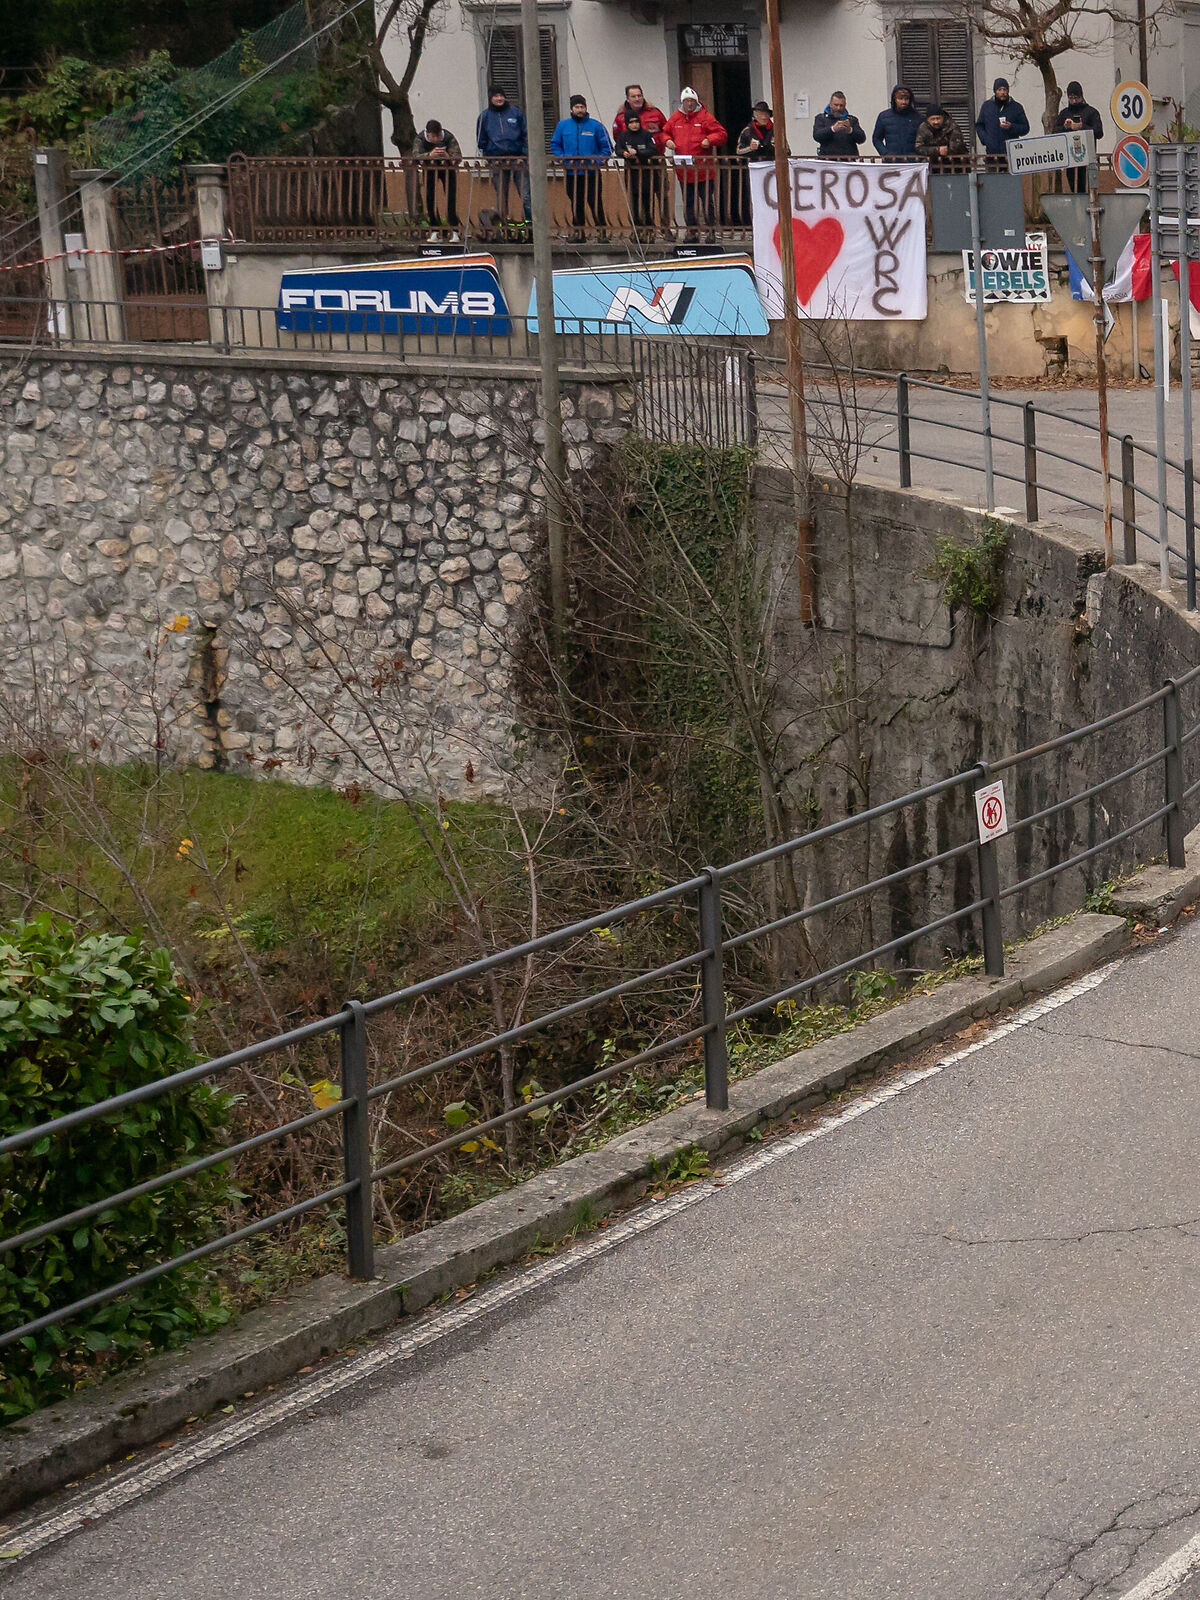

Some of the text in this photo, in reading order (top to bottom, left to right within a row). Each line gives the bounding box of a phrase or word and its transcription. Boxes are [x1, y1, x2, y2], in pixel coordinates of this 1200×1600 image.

[1121, 94, 1143, 119] 30
[1014, 142, 1023, 150] via
[1016, 150, 1064, 169] provinciale
[865, 216, 912, 316] WRC
[281, 288, 496, 316] FORUM8
